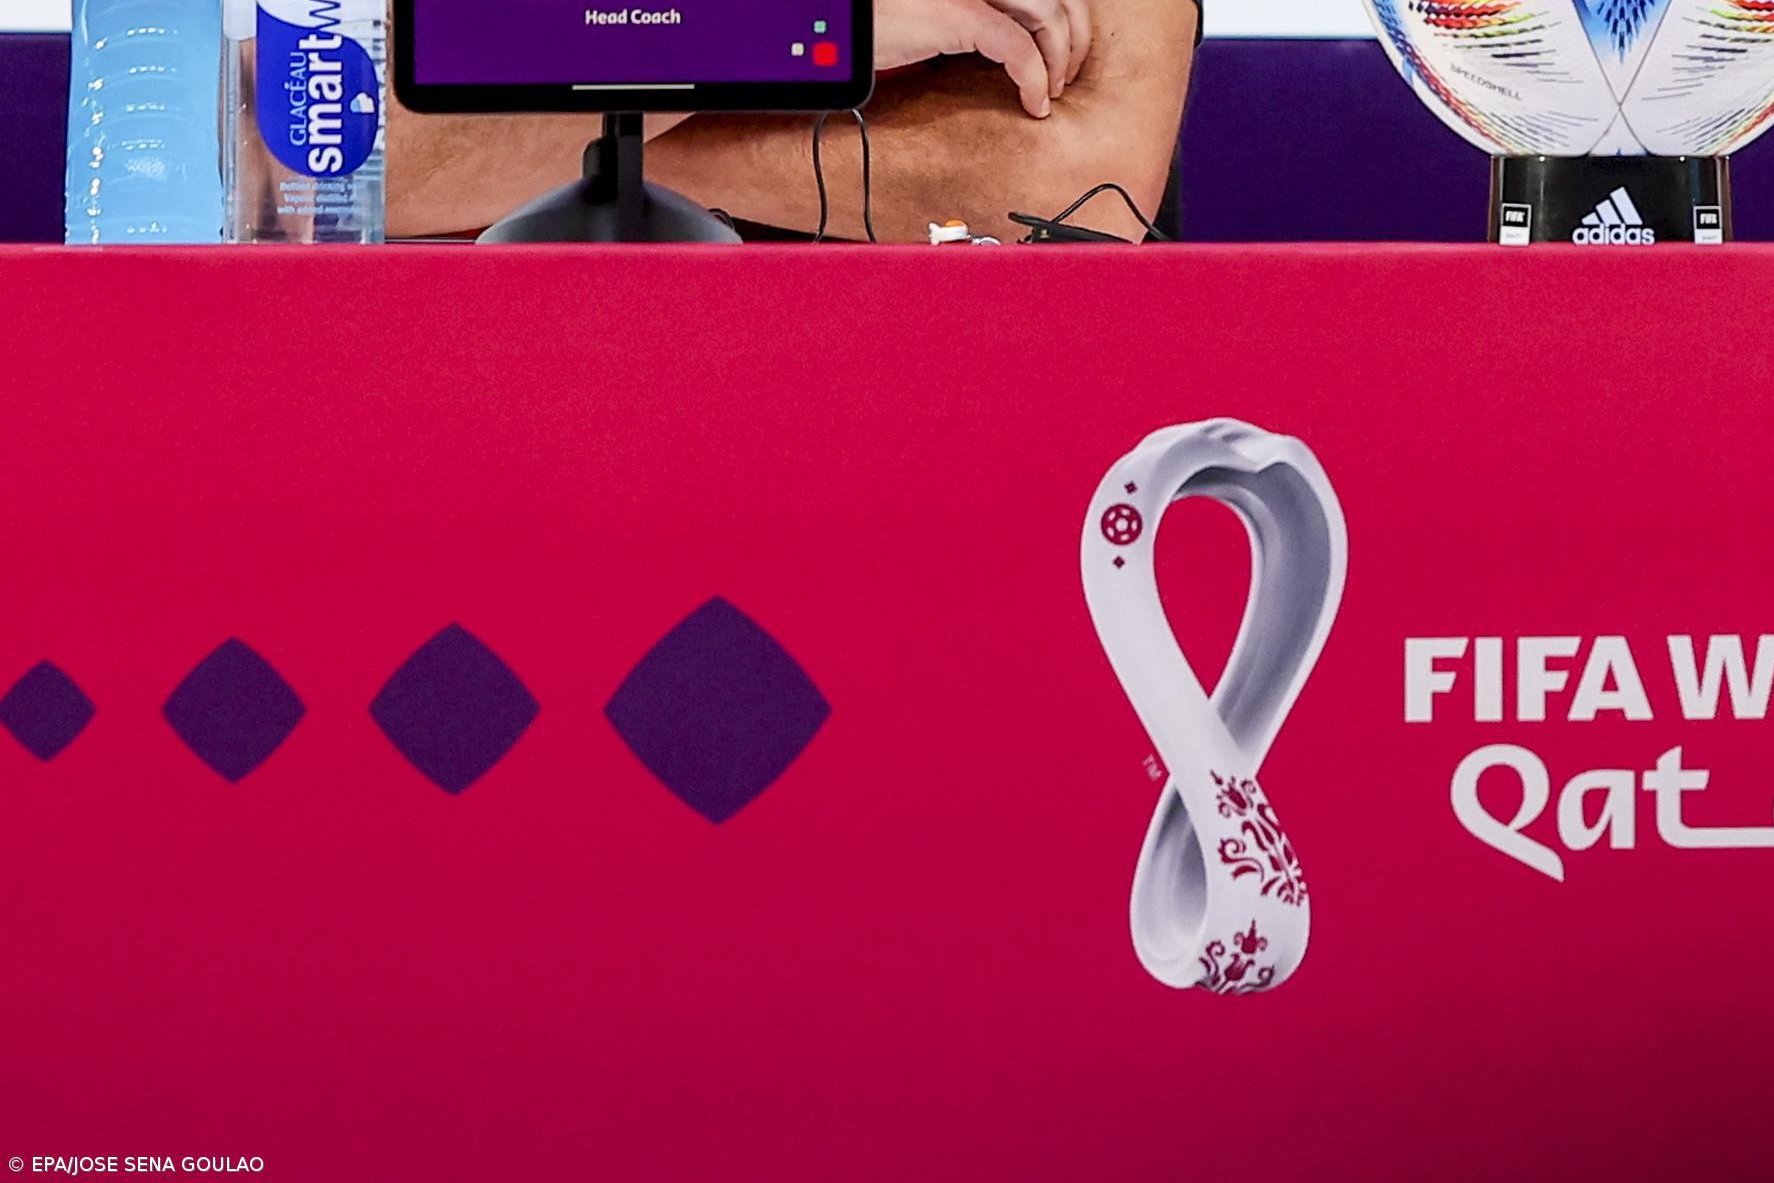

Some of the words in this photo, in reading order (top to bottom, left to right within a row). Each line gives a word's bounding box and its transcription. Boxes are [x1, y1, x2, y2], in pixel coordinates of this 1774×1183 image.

[585, 8, 628, 25] Head
[632, 8, 681, 25] Coach
[285, 51, 307, 146] GLACÉAU
[1572, 223, 1655, 245] adidas
[1403, 637, 1652, 723] FIFA
